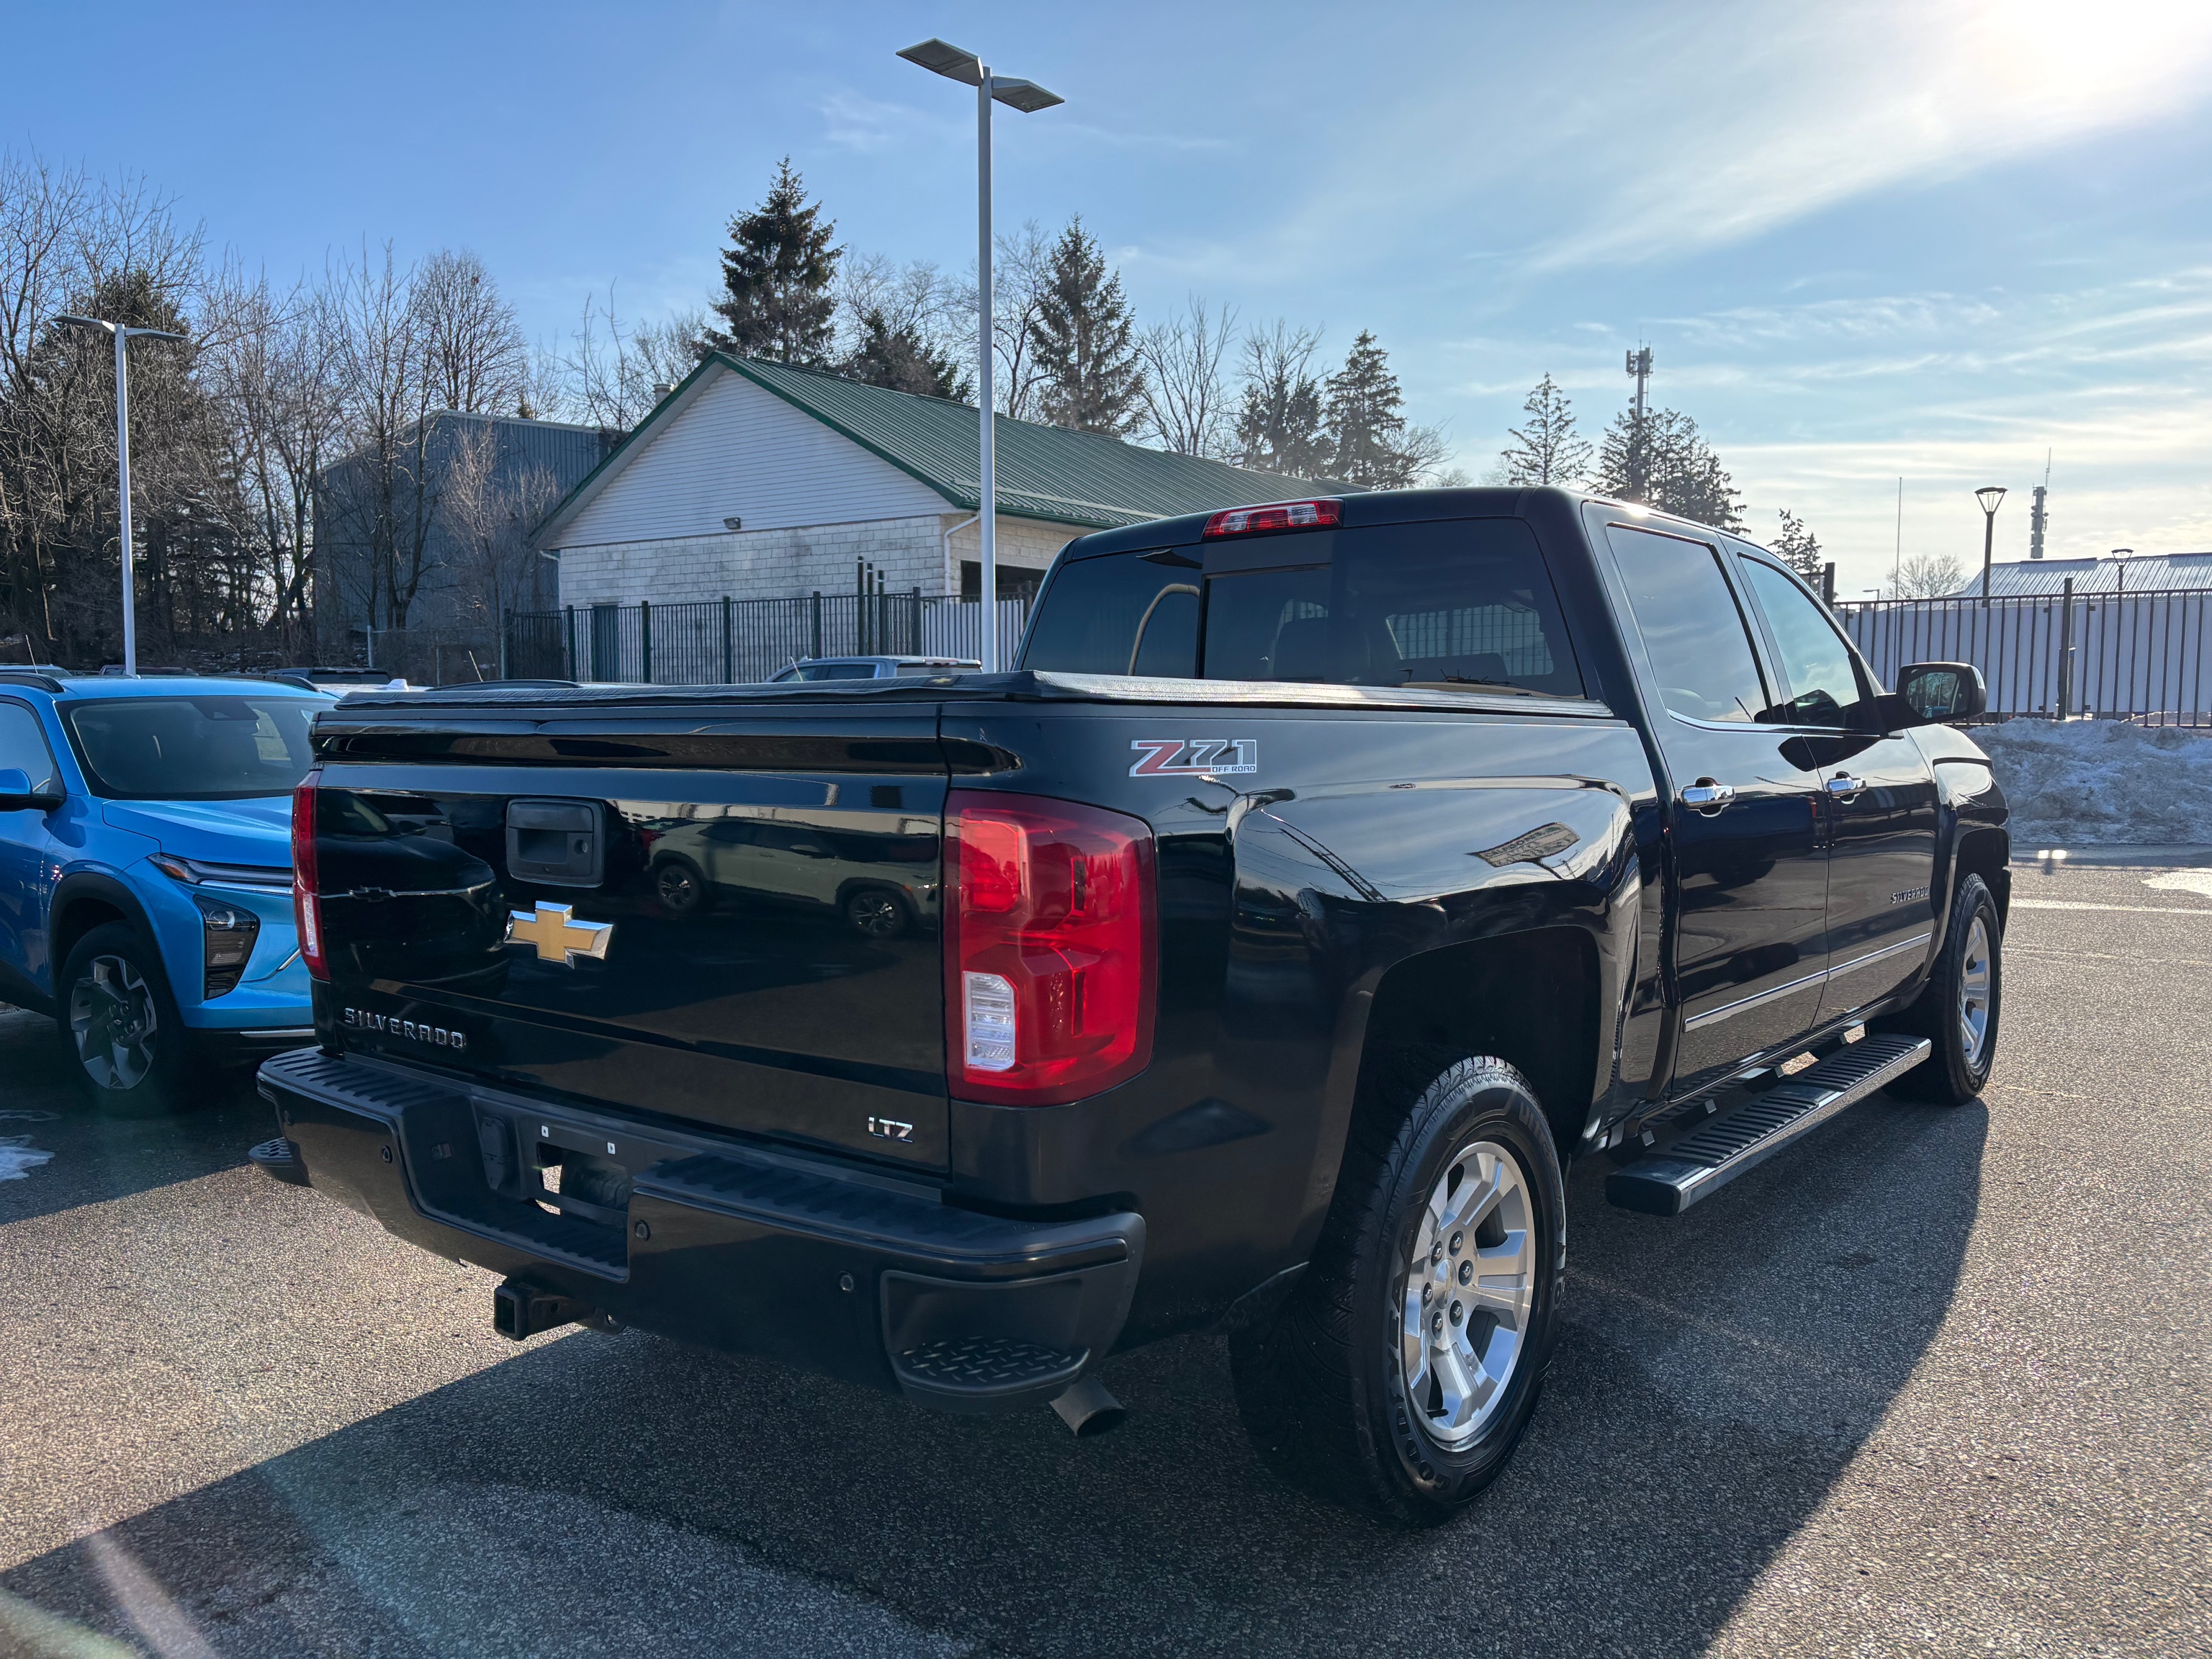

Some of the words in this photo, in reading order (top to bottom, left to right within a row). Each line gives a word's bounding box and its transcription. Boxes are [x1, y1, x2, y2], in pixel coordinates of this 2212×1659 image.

[1128, 739, 1257, 777] Z71
[1891, 886, 1929, 904] SILVERADO
[344, 1007, 467, 1049] SILVERADO
[868, 1116, 914, 1143] LTZ
